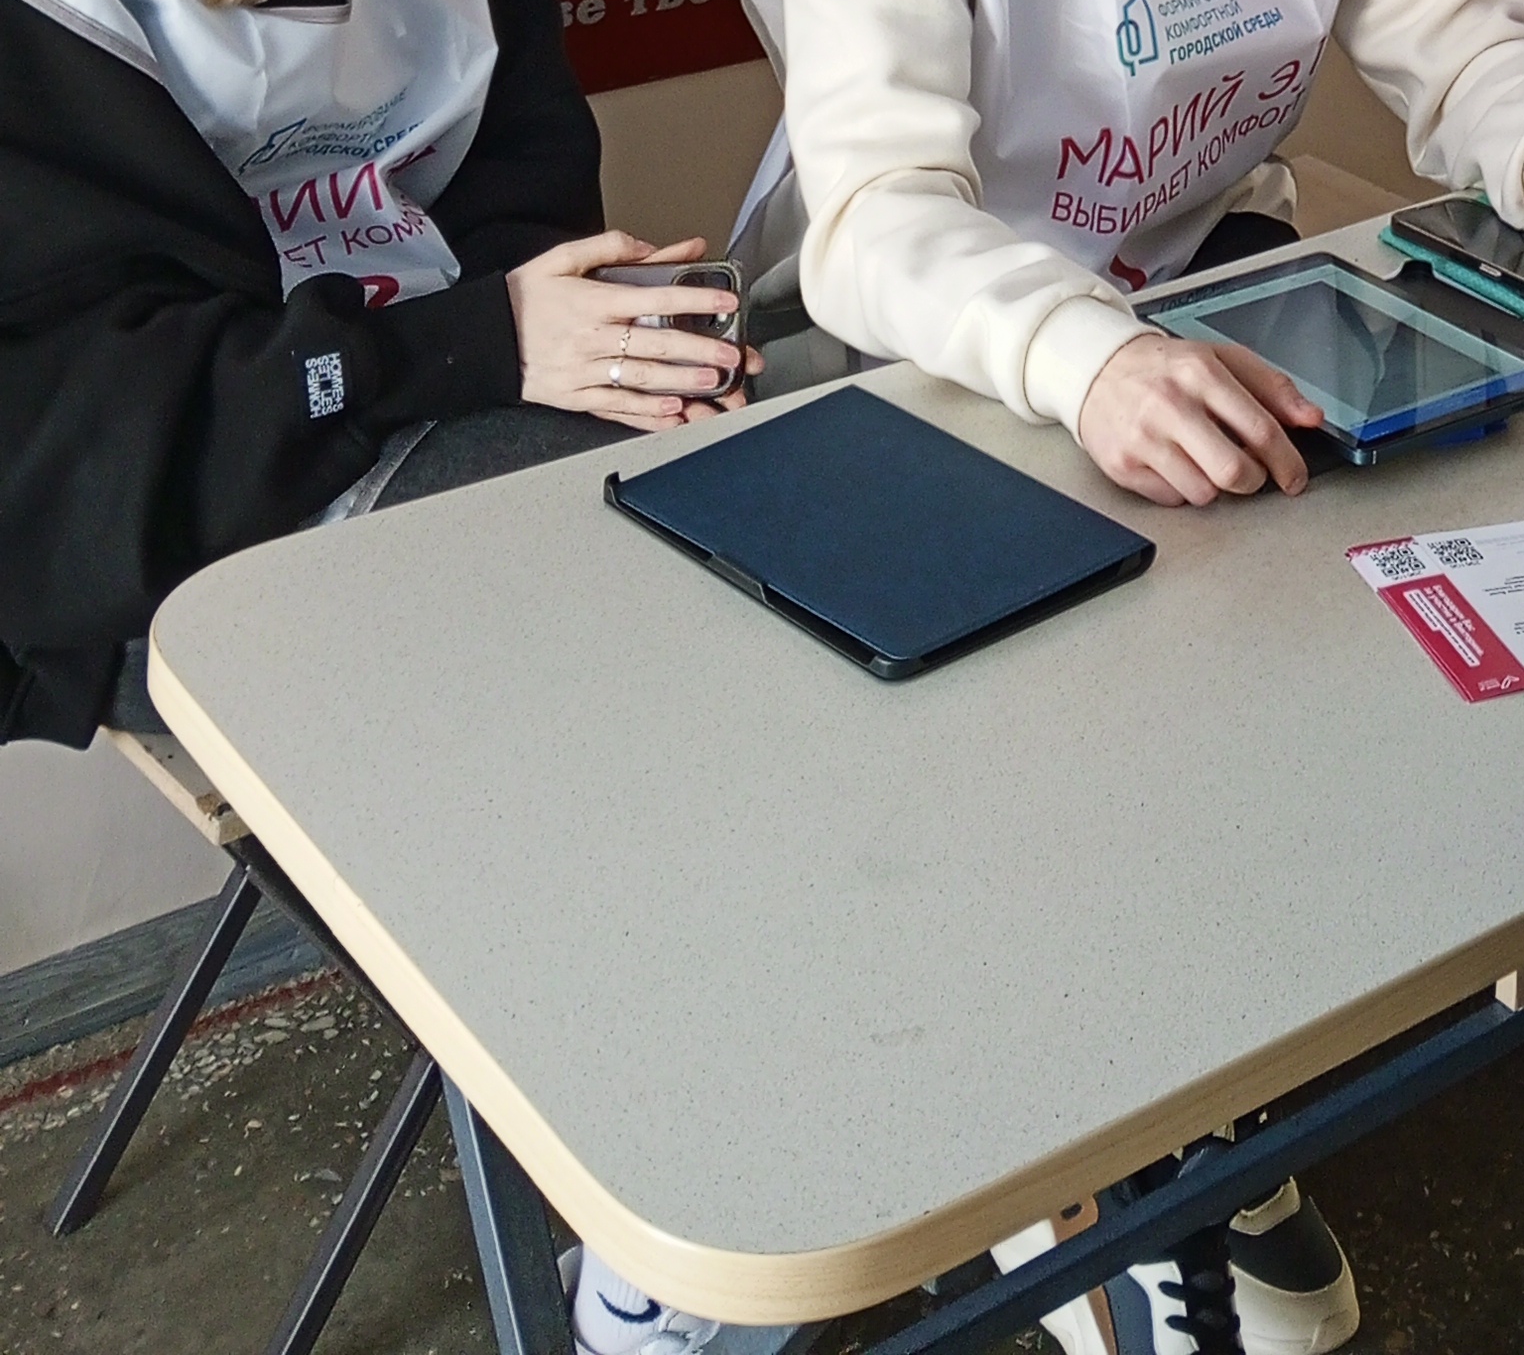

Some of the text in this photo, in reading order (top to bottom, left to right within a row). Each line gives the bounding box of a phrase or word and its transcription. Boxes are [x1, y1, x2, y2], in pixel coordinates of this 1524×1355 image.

[1169, 7, 1285, 66] ГОРОДСКОЙ СРЕДЫ
[1057, 70, 1246, 187] МАРИЙ
[1051, 159, 1193, 235] ВЫБИРАЕТ
